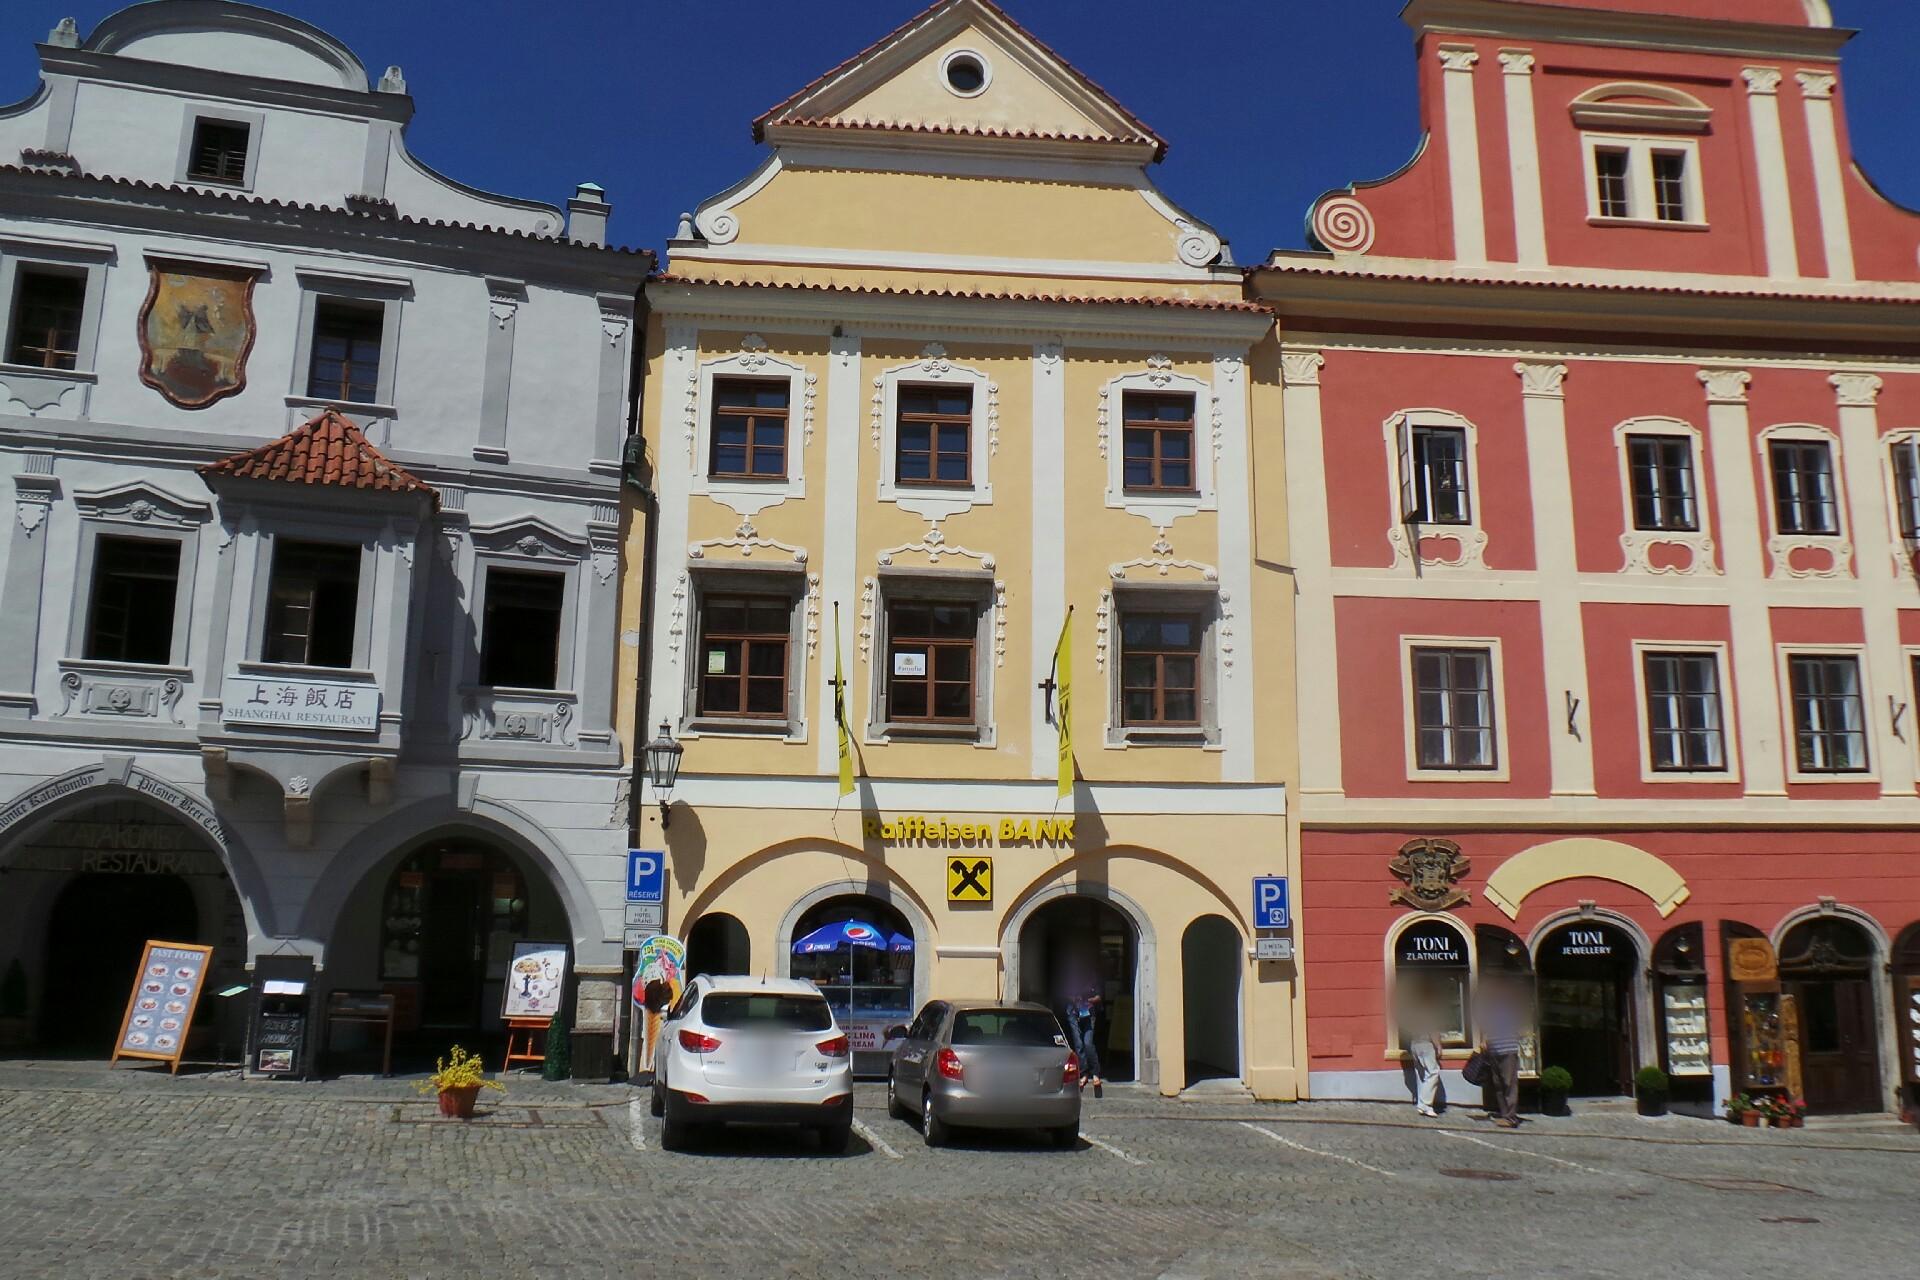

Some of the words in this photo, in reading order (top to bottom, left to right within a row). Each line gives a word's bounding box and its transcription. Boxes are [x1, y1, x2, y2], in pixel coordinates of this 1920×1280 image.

[248, 684, 355, 709] 上海飯店
[227, 708, 292, 721] SHANGHAI
[296, 711, 374, 725] RESTAURANT
[29, 775, 95, 807] Katakomby
[136, 776, 179, 803] Pilsner
[179, 796, 205, 819] Beer
[864, 815, 991, 839] Raiffeisen
[999, 818, 1075, 840] BANK
[634, 857, 657, 886] P
[628, 890, 660, 899] RÉSERVÉ
[1260, 883, 1281, 913] P
[1413, 936, 1449, 950] TONI
[1568, 931, 1605, 945] TONI
[150, 948, 173, 958] FAST
[174, 950, 203, 961] FOOD
[1406, 950, 1459, 961] ZLATNICTVÍ
[1562, 946, 1612, 955] JEWELLERY
